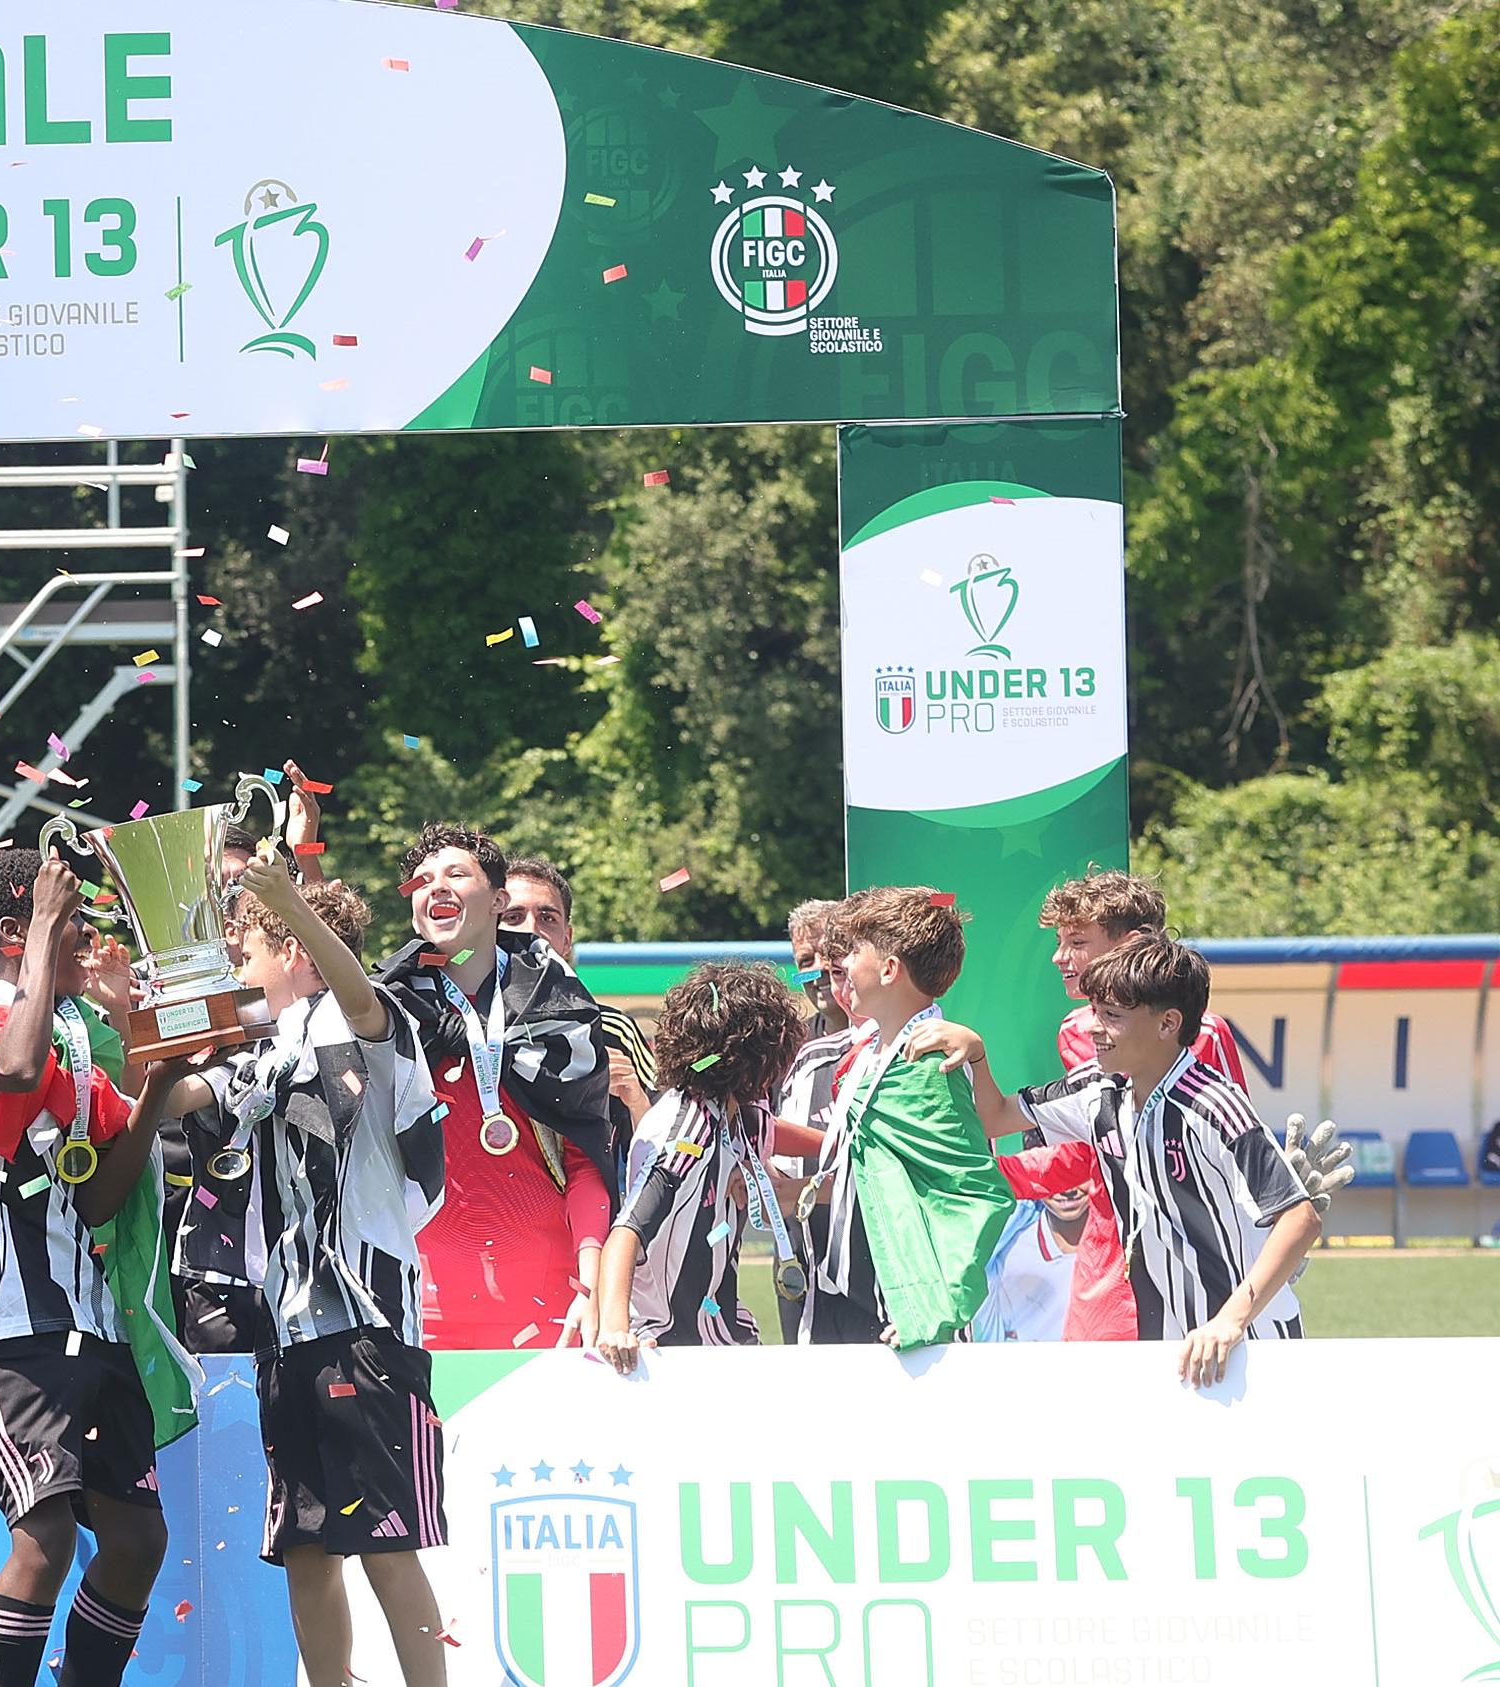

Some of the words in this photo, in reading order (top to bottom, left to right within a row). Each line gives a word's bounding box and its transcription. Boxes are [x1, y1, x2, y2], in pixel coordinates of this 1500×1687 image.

[42, 197, 138, 278] 13
[743, 240, 806, 267] FIGC
[762, 269, 787, 278] ITALIA
[8, 301, 139, 327] GIOVANILE
[809, 317, 859, 329] SETTORE
[810, 329, 870, 341] GIOVANILE
[873, 328, 881, 340] E
[810, 340, 883, 353] SCOLASTICO
[878, 680, 912, 692] ITALIA
[925, 668, 1047, 700] UNDER
[1059, 667, 1096, 697] 13
[926, 702, 994, 734] PRO
[1002, 706, 1045, 717] SETTORE
[1046, 705, 1097, 716] GIOVANILE
[1002, 718, 1008, 728] E
[1011, 717, 1069, 728] SCOLASTICO
[59, 1002, 79, 1024] 202
[1393, 1016, 1410, 1090] I
[504, 1514, 625, 1550] ITALIA
[678, 1478, 1129, 1585] UNDER
[1175, 1476, 1310, 1580] 13
[685, 1598, 935, 1687] PRO
